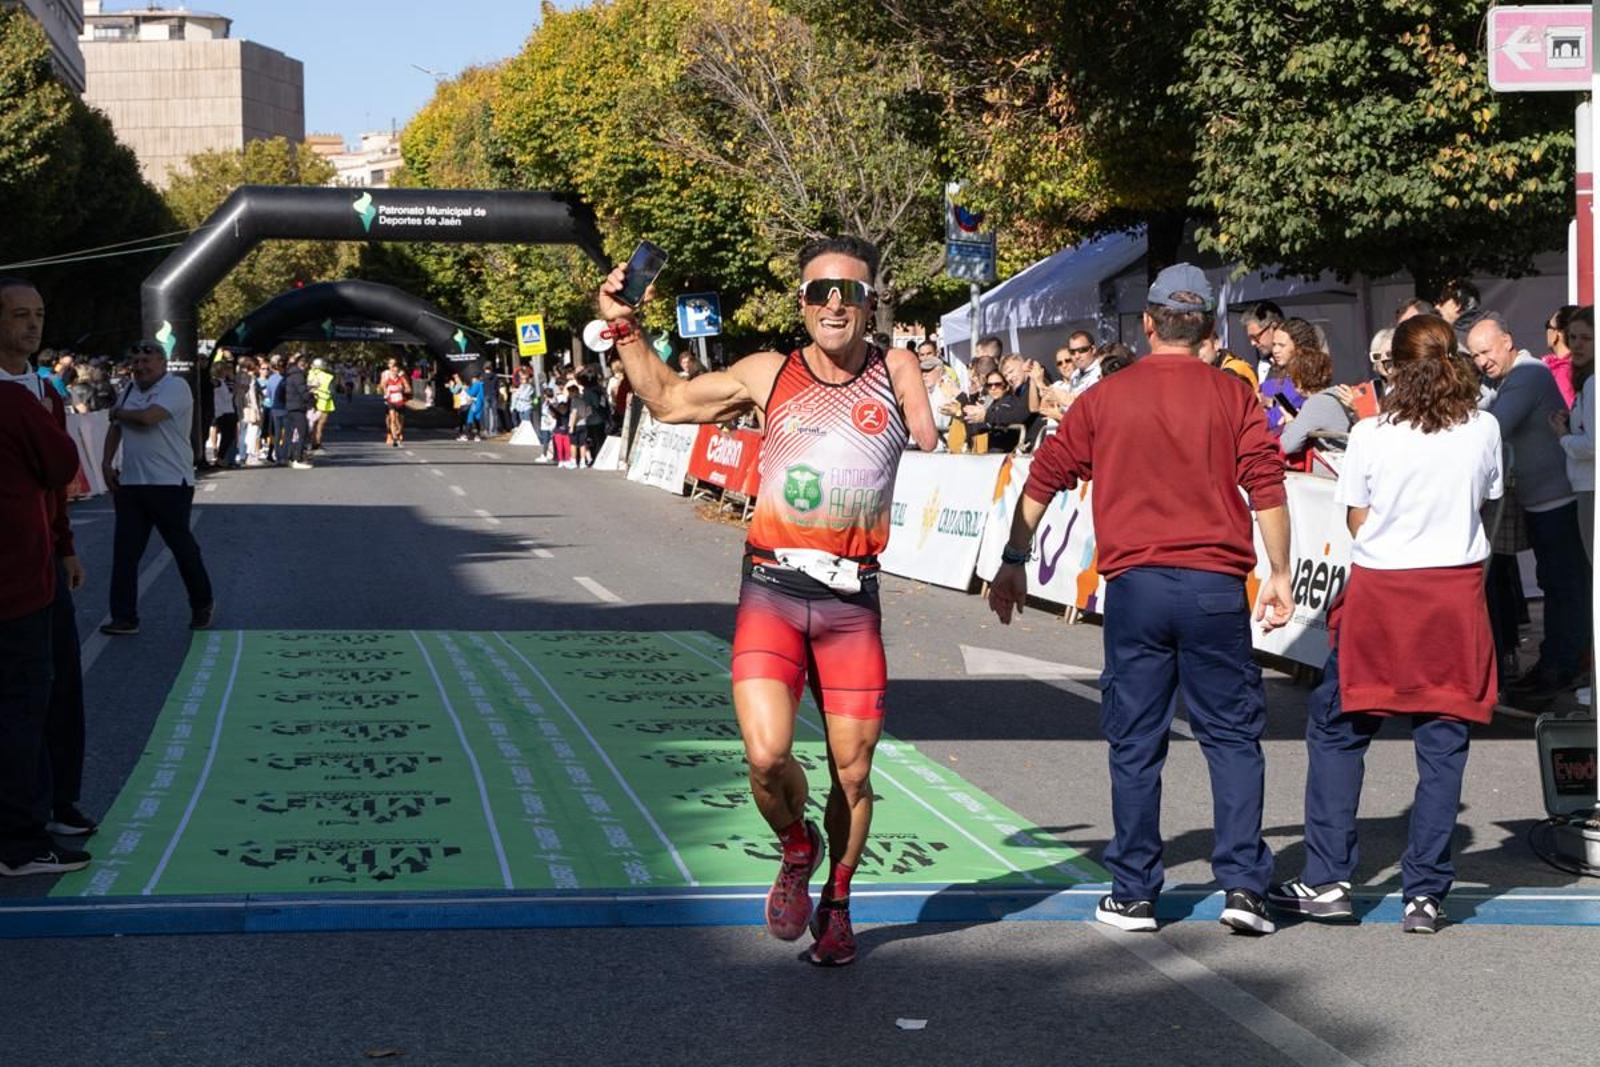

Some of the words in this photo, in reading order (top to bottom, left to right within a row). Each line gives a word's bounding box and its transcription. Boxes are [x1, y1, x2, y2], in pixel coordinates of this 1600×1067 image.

[378, 205, 424, 215] Patronato
[426, 206, 472, 217] Municipal
[473, 207, 487, 216] de
[378, 216, 422, 226] Deportes
[424, 217, 435, 226] de
[438, 217, 462, 226] Jaén
[827, 570, 838, 582] 7
